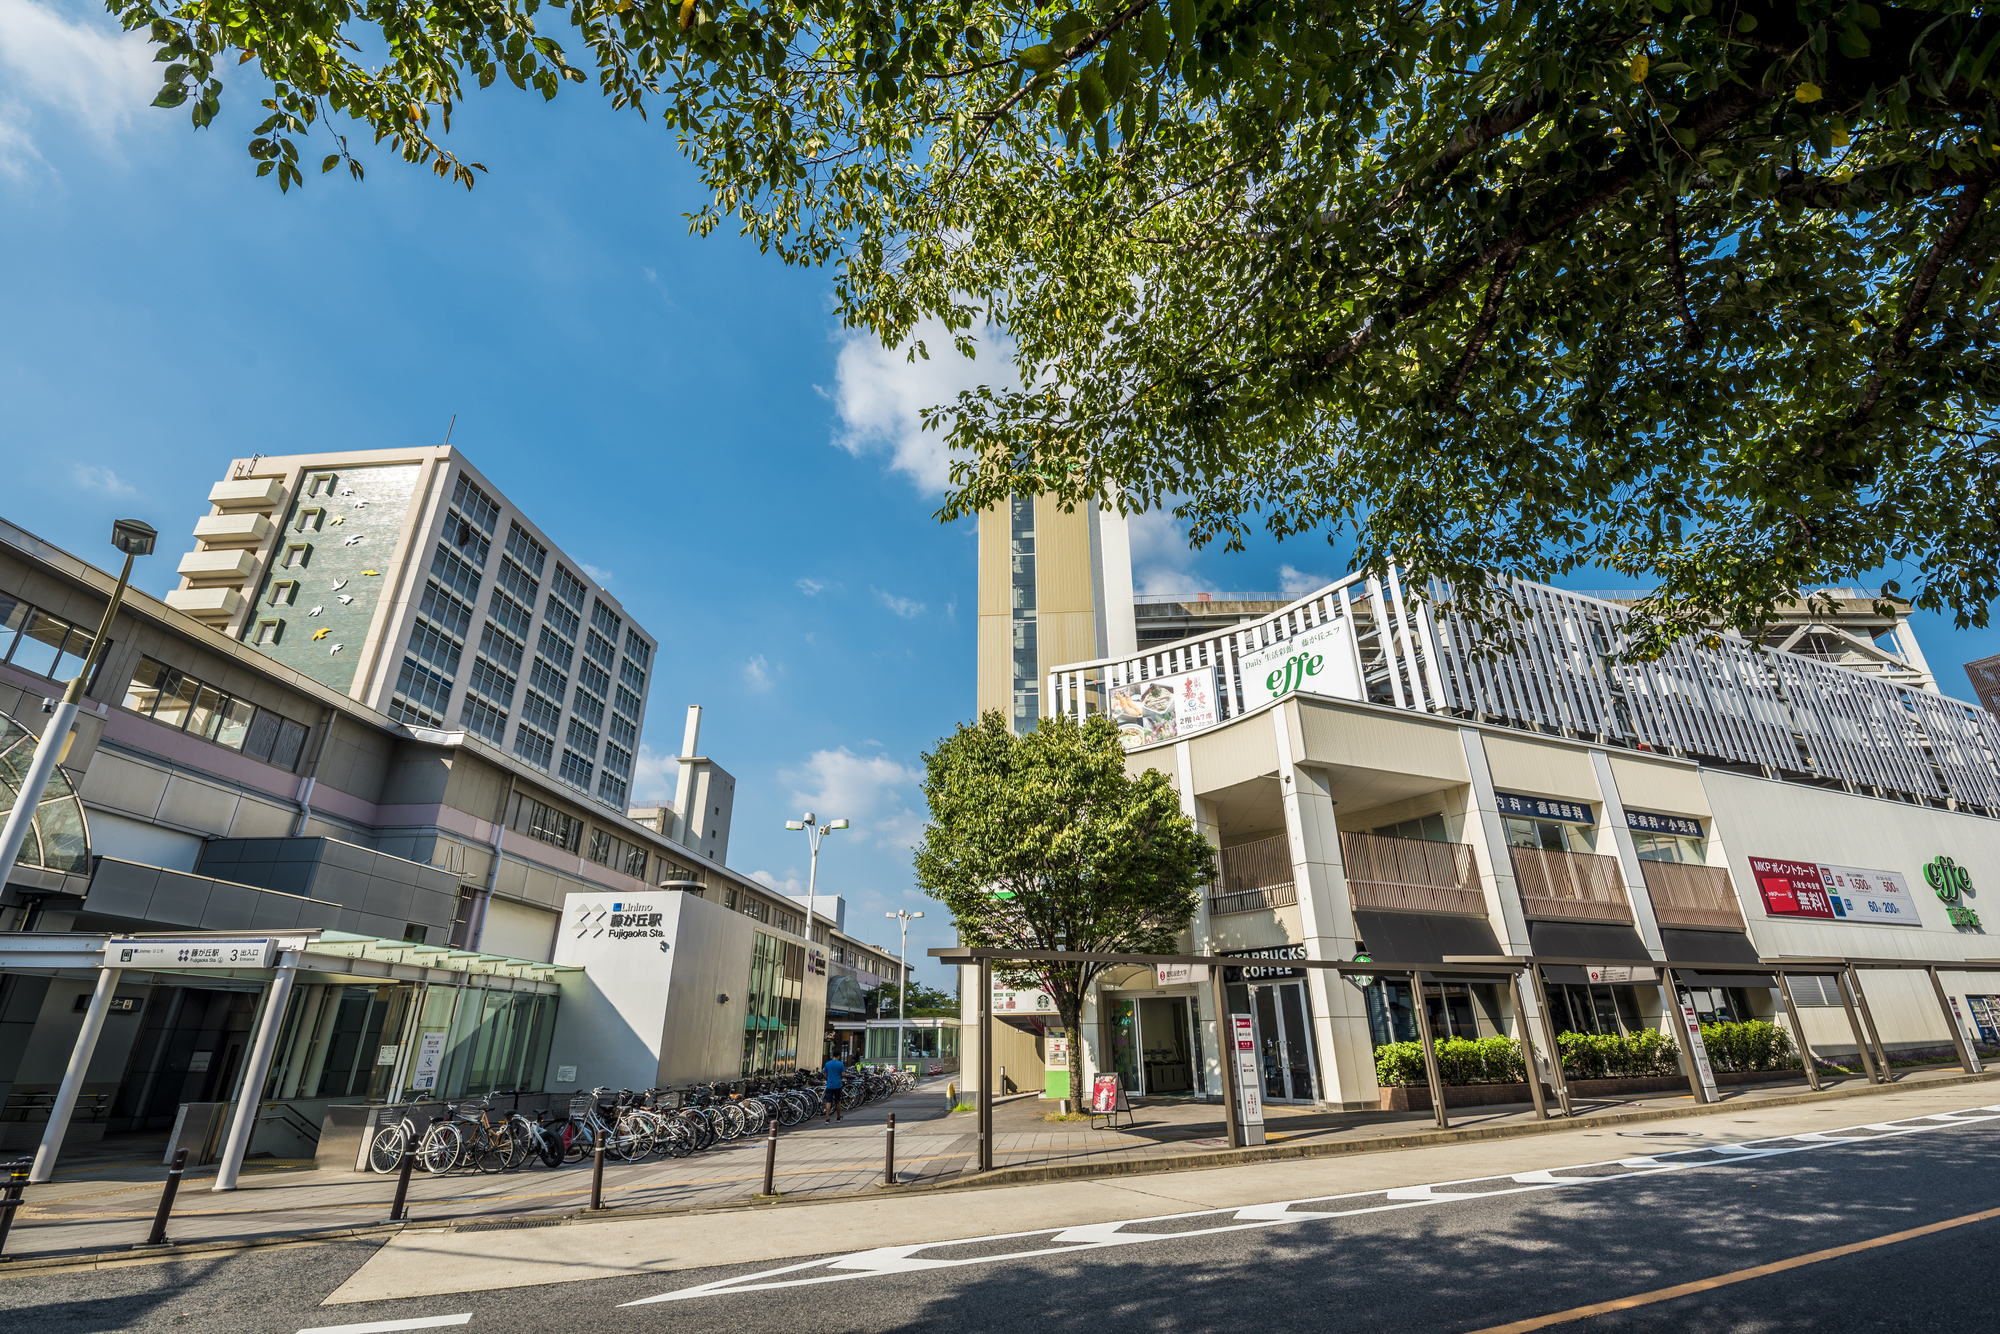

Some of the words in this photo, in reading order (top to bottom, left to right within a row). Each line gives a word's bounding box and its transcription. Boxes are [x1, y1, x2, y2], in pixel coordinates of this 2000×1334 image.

[1244, 658, 1262, 669] Daily
[1266, 652, 1324, 698] effe
[1753, 861, 1771, 872] MKP
[1772, 862, 1815, 877] ポイントカード
[1923, 855, 1973, 901] effe
[621, 903, 653, 912] Linimo
[610, 913, 662, 927] 藤が丘駅
[608, 929, 648, 940] Fujigaoka
[649, 929, 665, 938] Sta.
[190, 949, 220, 957] 藤が丘駅
[229, 949, 238, 962] 3
[1228, 947, 1306, 961] ARBUCKS
[1242, 966, 1293, 978] COFFEE
